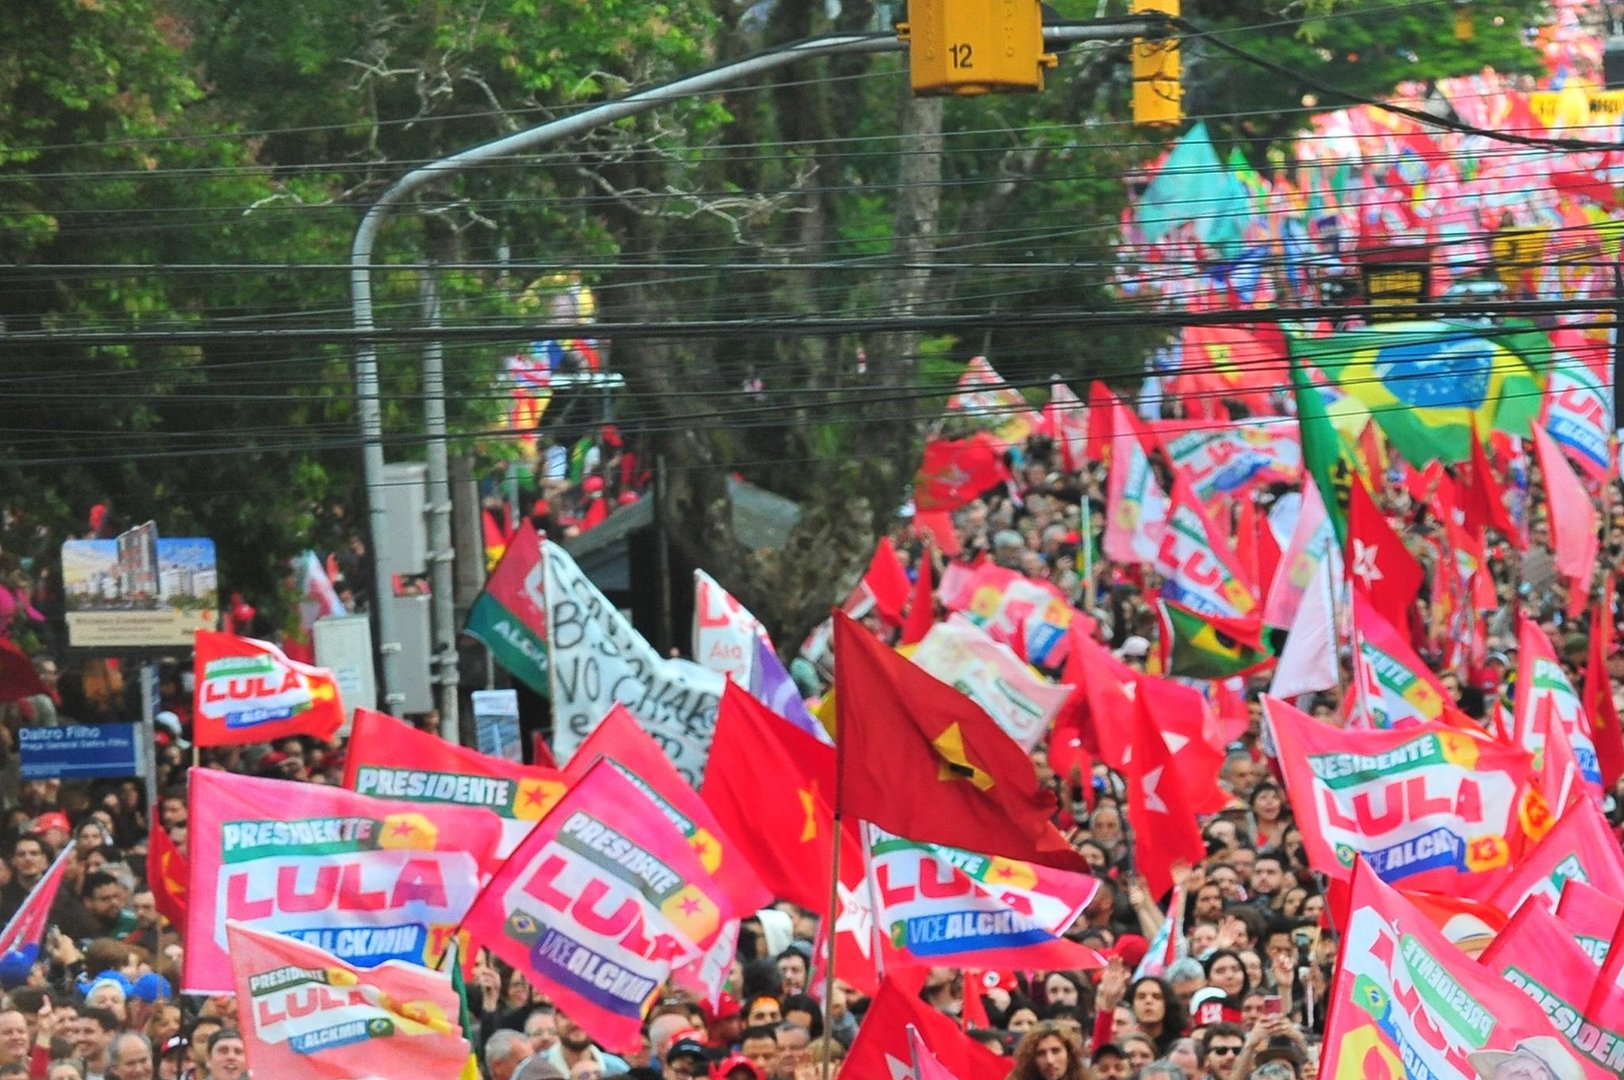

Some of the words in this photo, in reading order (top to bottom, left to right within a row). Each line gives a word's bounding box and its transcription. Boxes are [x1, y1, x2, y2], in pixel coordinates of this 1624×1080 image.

[948, 44, 973, 69] 12
[206, 670, 303, 702] LULA
[357, 768, 508, 806] PRESIDENTE
[1324, 775, 1484, 837] LULA
[223, 819, 375, 852] PRESIDENTE
[227, 858, 449, 922] LULA
[910, 914, 946, 944] VICE
